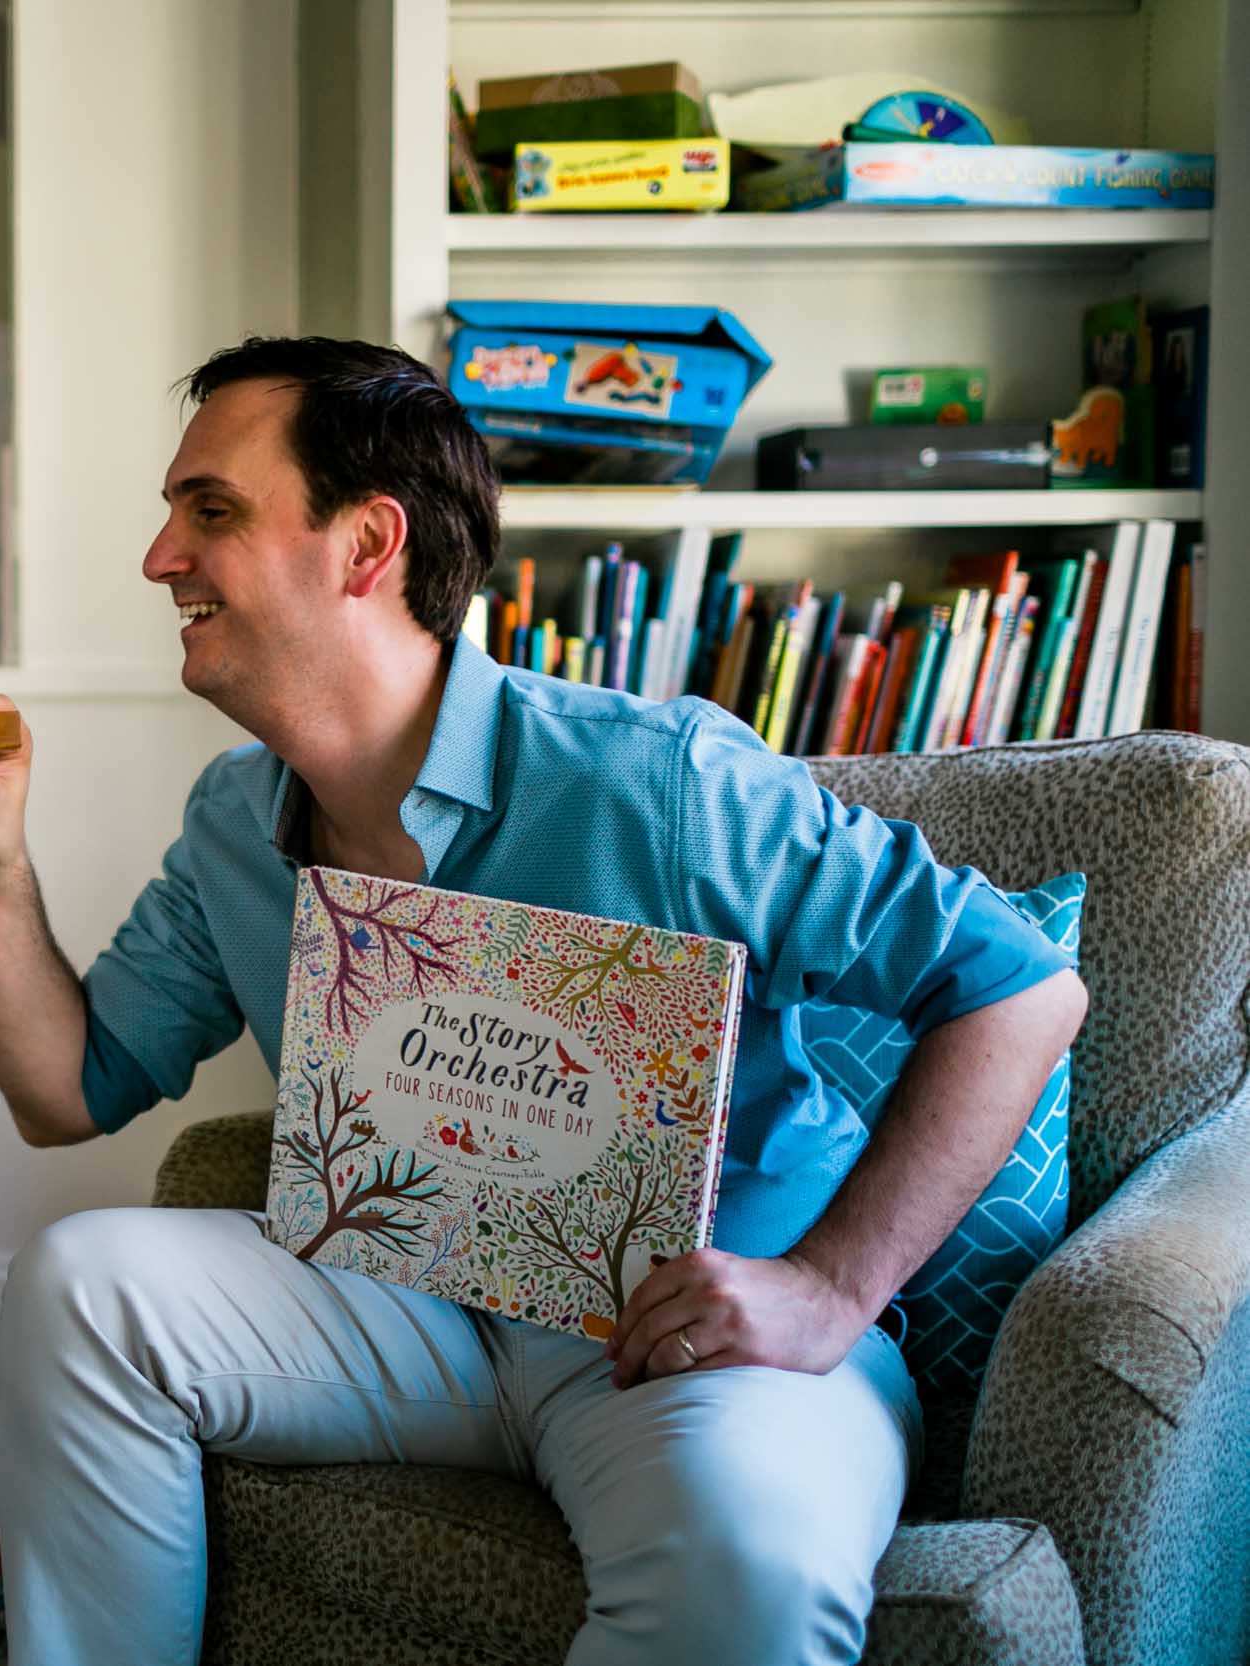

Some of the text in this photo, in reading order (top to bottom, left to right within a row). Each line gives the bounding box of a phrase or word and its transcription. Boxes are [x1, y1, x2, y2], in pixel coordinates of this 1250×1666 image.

[421, 1002, 551, 1066] The Story
[400, 1028, 590, 1108] Orchestra
[385, 1071, 594, 1137] FOUR SEASONS IN ONE DAY
